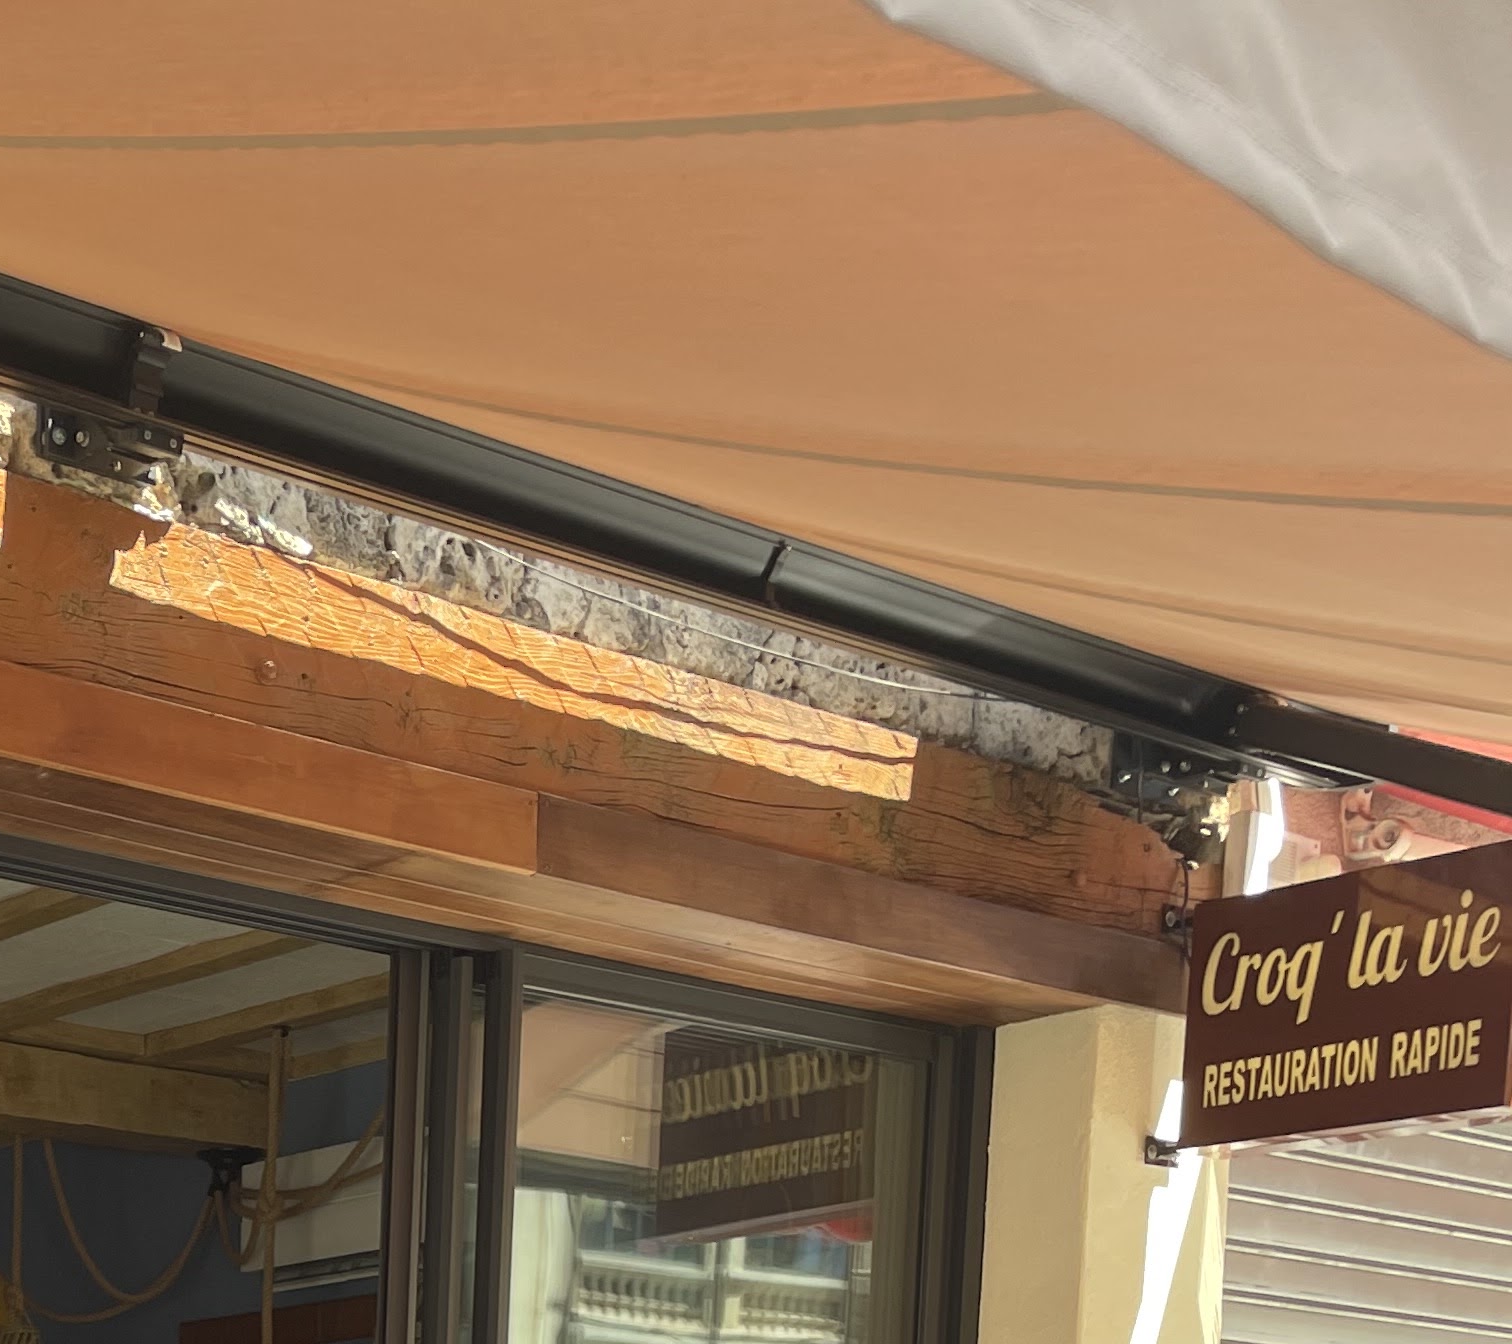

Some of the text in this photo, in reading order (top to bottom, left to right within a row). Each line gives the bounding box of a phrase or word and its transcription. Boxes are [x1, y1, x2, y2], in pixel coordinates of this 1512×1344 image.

[1347, 910, 1408, 990] la
[1418, 889, 1502, 978] vie
[1202, 1018, 1482, 1108] RESTAURATION RAPIDE
